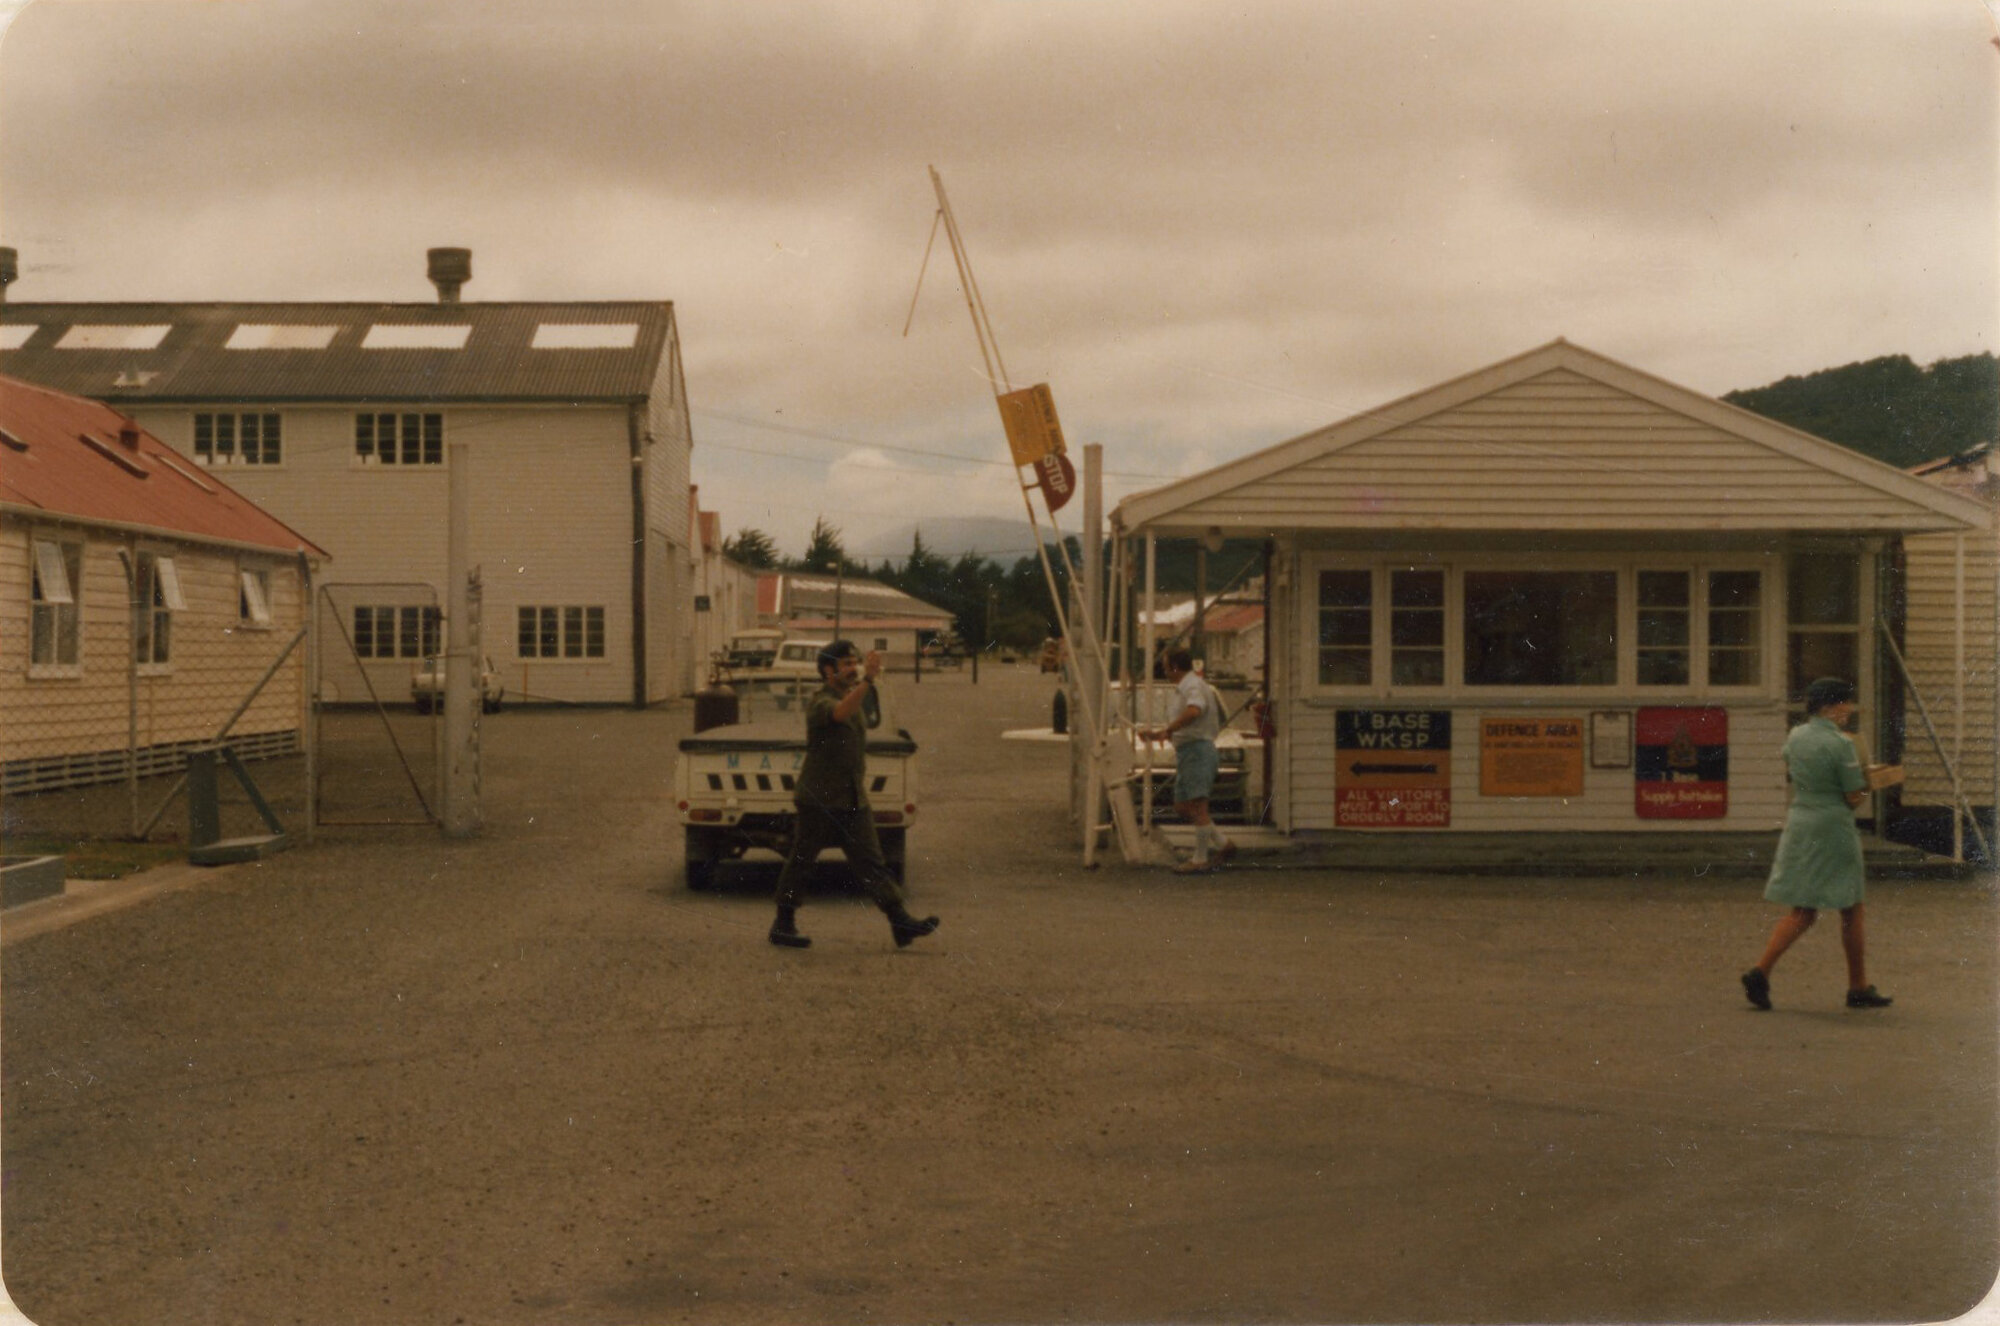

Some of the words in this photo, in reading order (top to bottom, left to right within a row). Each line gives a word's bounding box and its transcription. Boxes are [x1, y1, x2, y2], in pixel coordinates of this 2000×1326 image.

[1043, 453, 1069, 494] STOP
[1371, 713, 1431, 729] BASE
[1486, 724, 1539, 737] DEFENCE
[1545, 724, 1578, 737] AREA
[1356, 732, 1430, 748] WKSP
[727, 753, 803, 770] MAZ
[1346, 789, 1369, 801] ALL
[1376, 789, 1443, 801] VISITORS
[1641, 789, 1676, 805] Supply
[1678, 789, 1724, 802] Battalion
[1339, 800, 1374, 812] MUST
[1379, 801, 1428, 812] REPORT
[1433, 801, 1449, 812] TO
[1340, 812, 1401, 823] ORDERLY
[1405, 812, 1446, 823] ROOM
